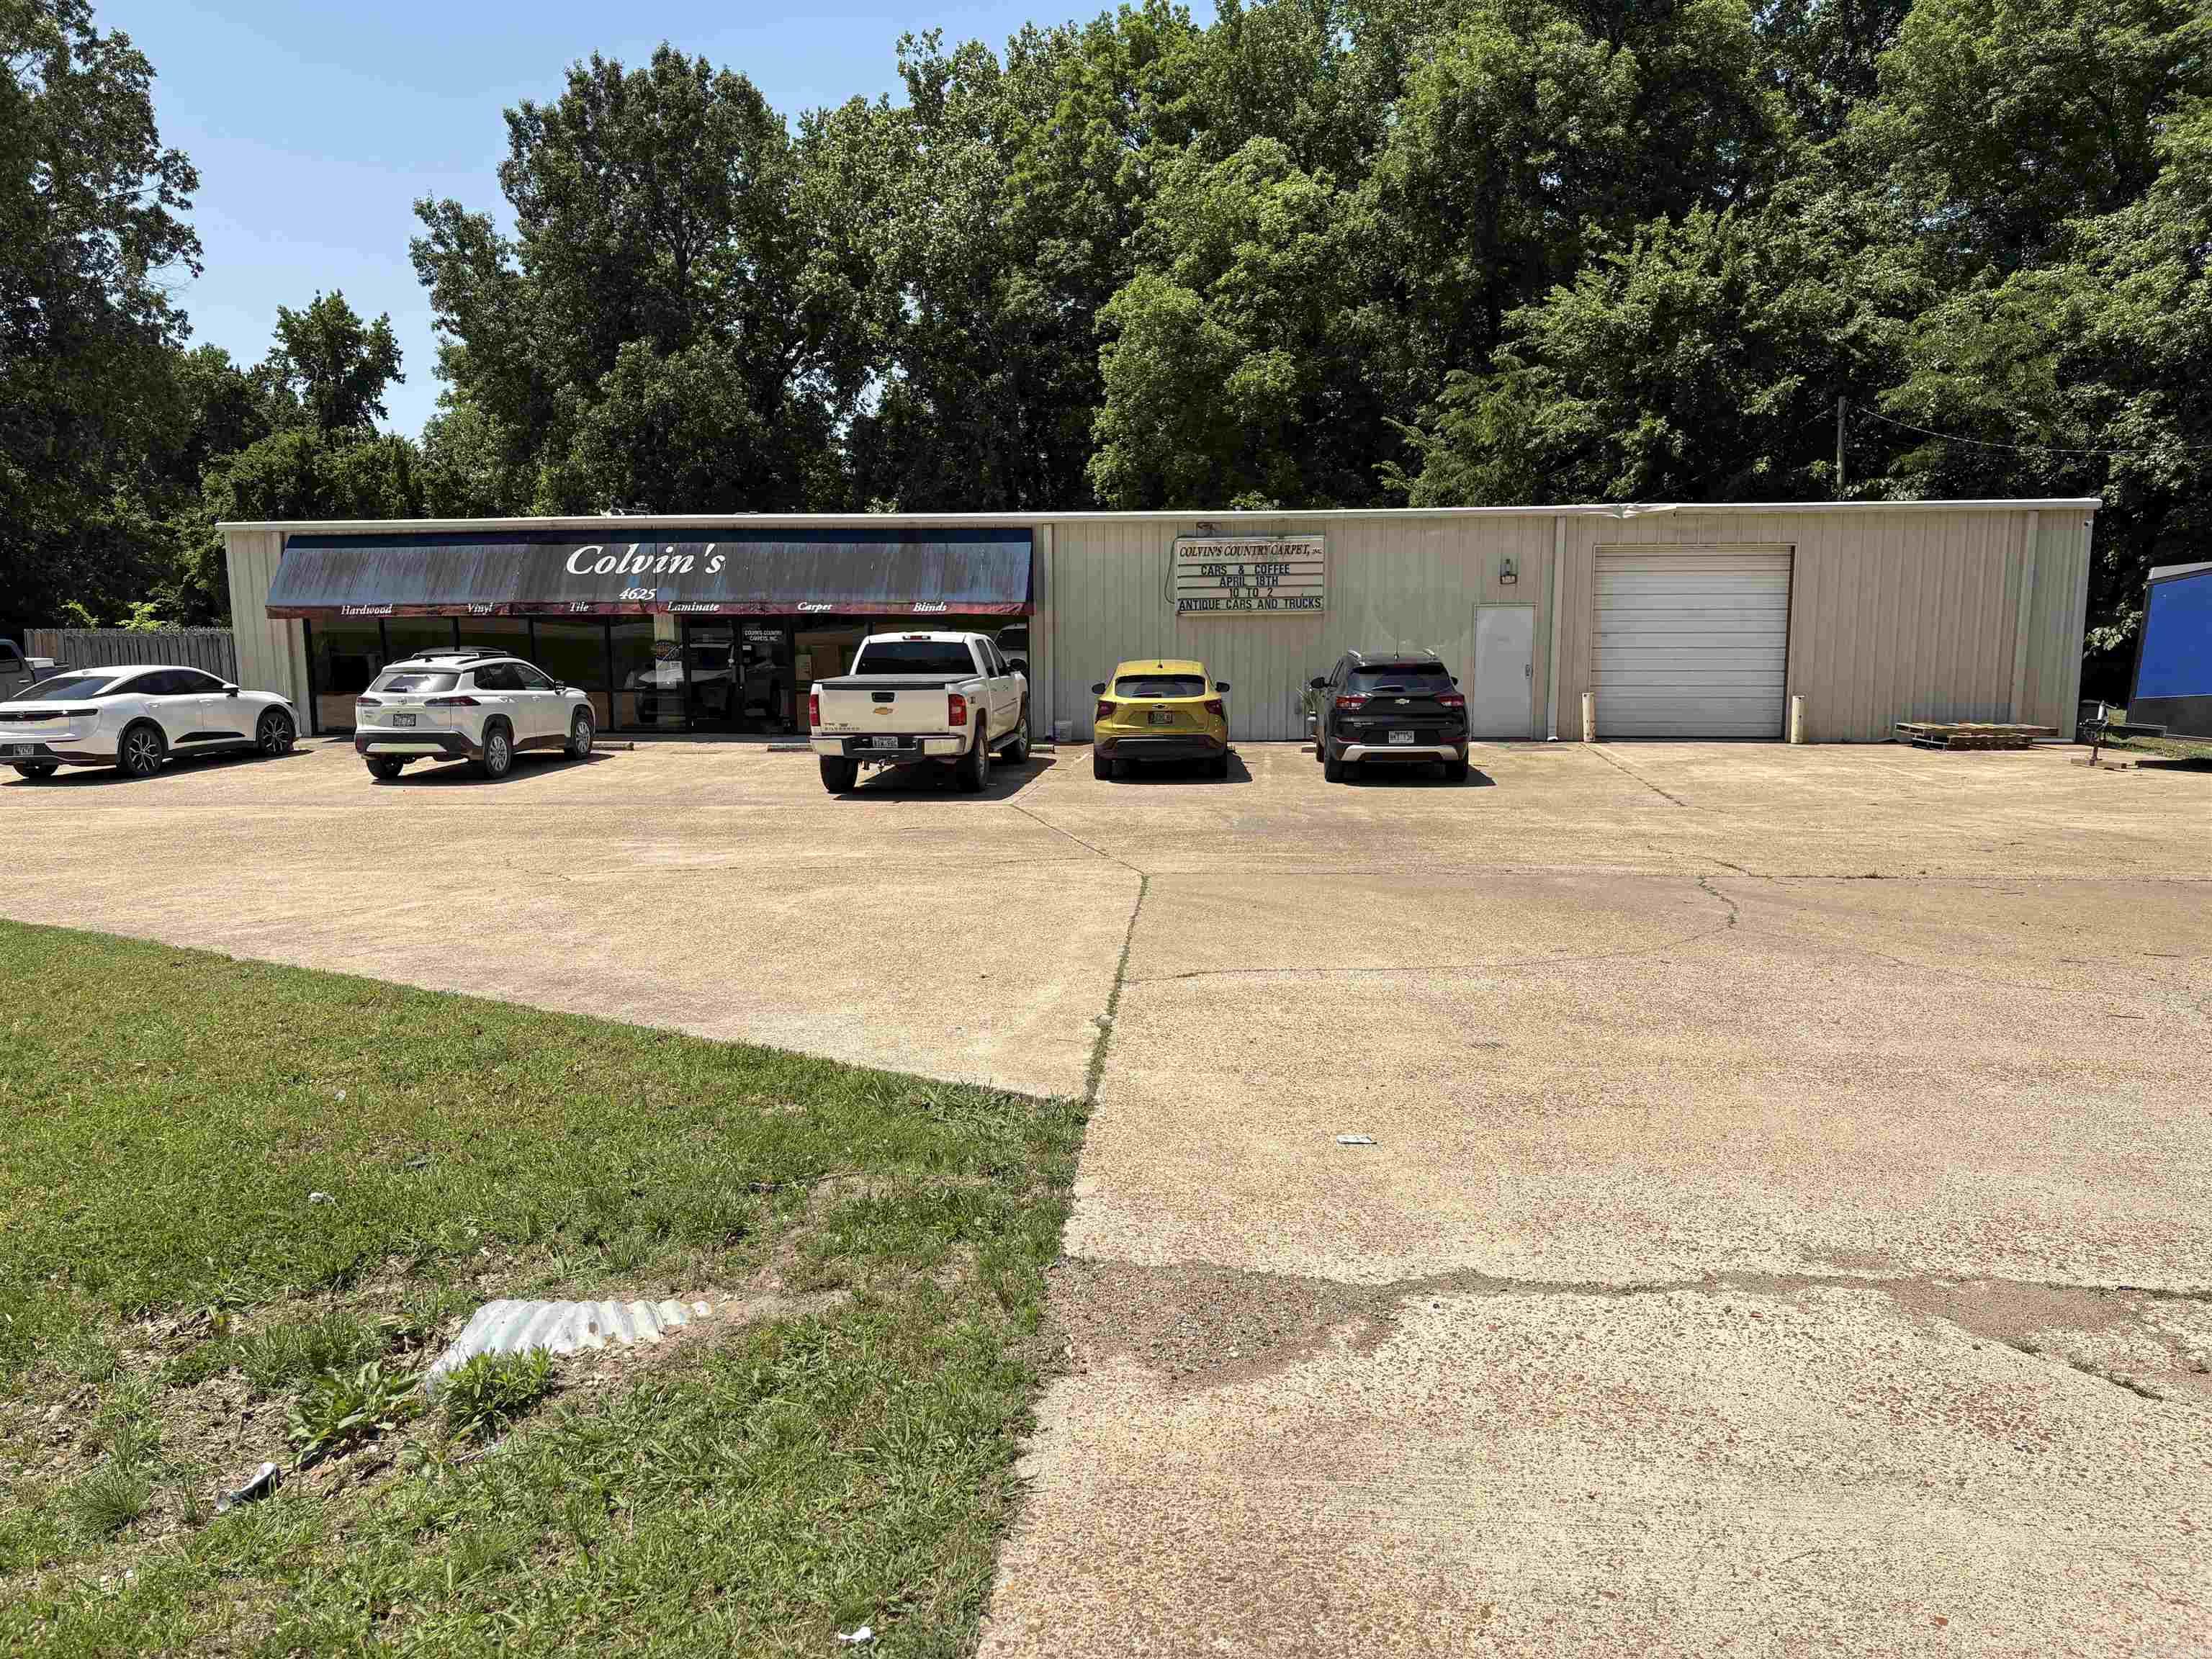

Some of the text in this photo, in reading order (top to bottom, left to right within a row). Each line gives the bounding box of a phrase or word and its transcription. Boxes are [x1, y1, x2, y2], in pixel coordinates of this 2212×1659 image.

[1179, 547, 1222, 557] COLVIN'S
[1224, 545, 1269, 557] COUNTRY
[566, 544, 726, 574] Colvin's
[1201, 564, 1290, 575] CARS & COFFEE
[1220, 576, 1246, 588] APRIL
[619, 588, 657, 599] 4625
[1228, 587, 1273, 598] 10 TO 2
[341, 603, 392, 616] Hardwood
[468, 602, 494, 614] Vinyl
[570, 601, 589, 611] Tile
[667, 601, 720, 611] Laminate
[797, 602, 833, 613] Carpet
[913, 602, 947, 611] Blinds
[1179, 598, 1321, 611] ANTIQUE CARS AND TRUCKS
